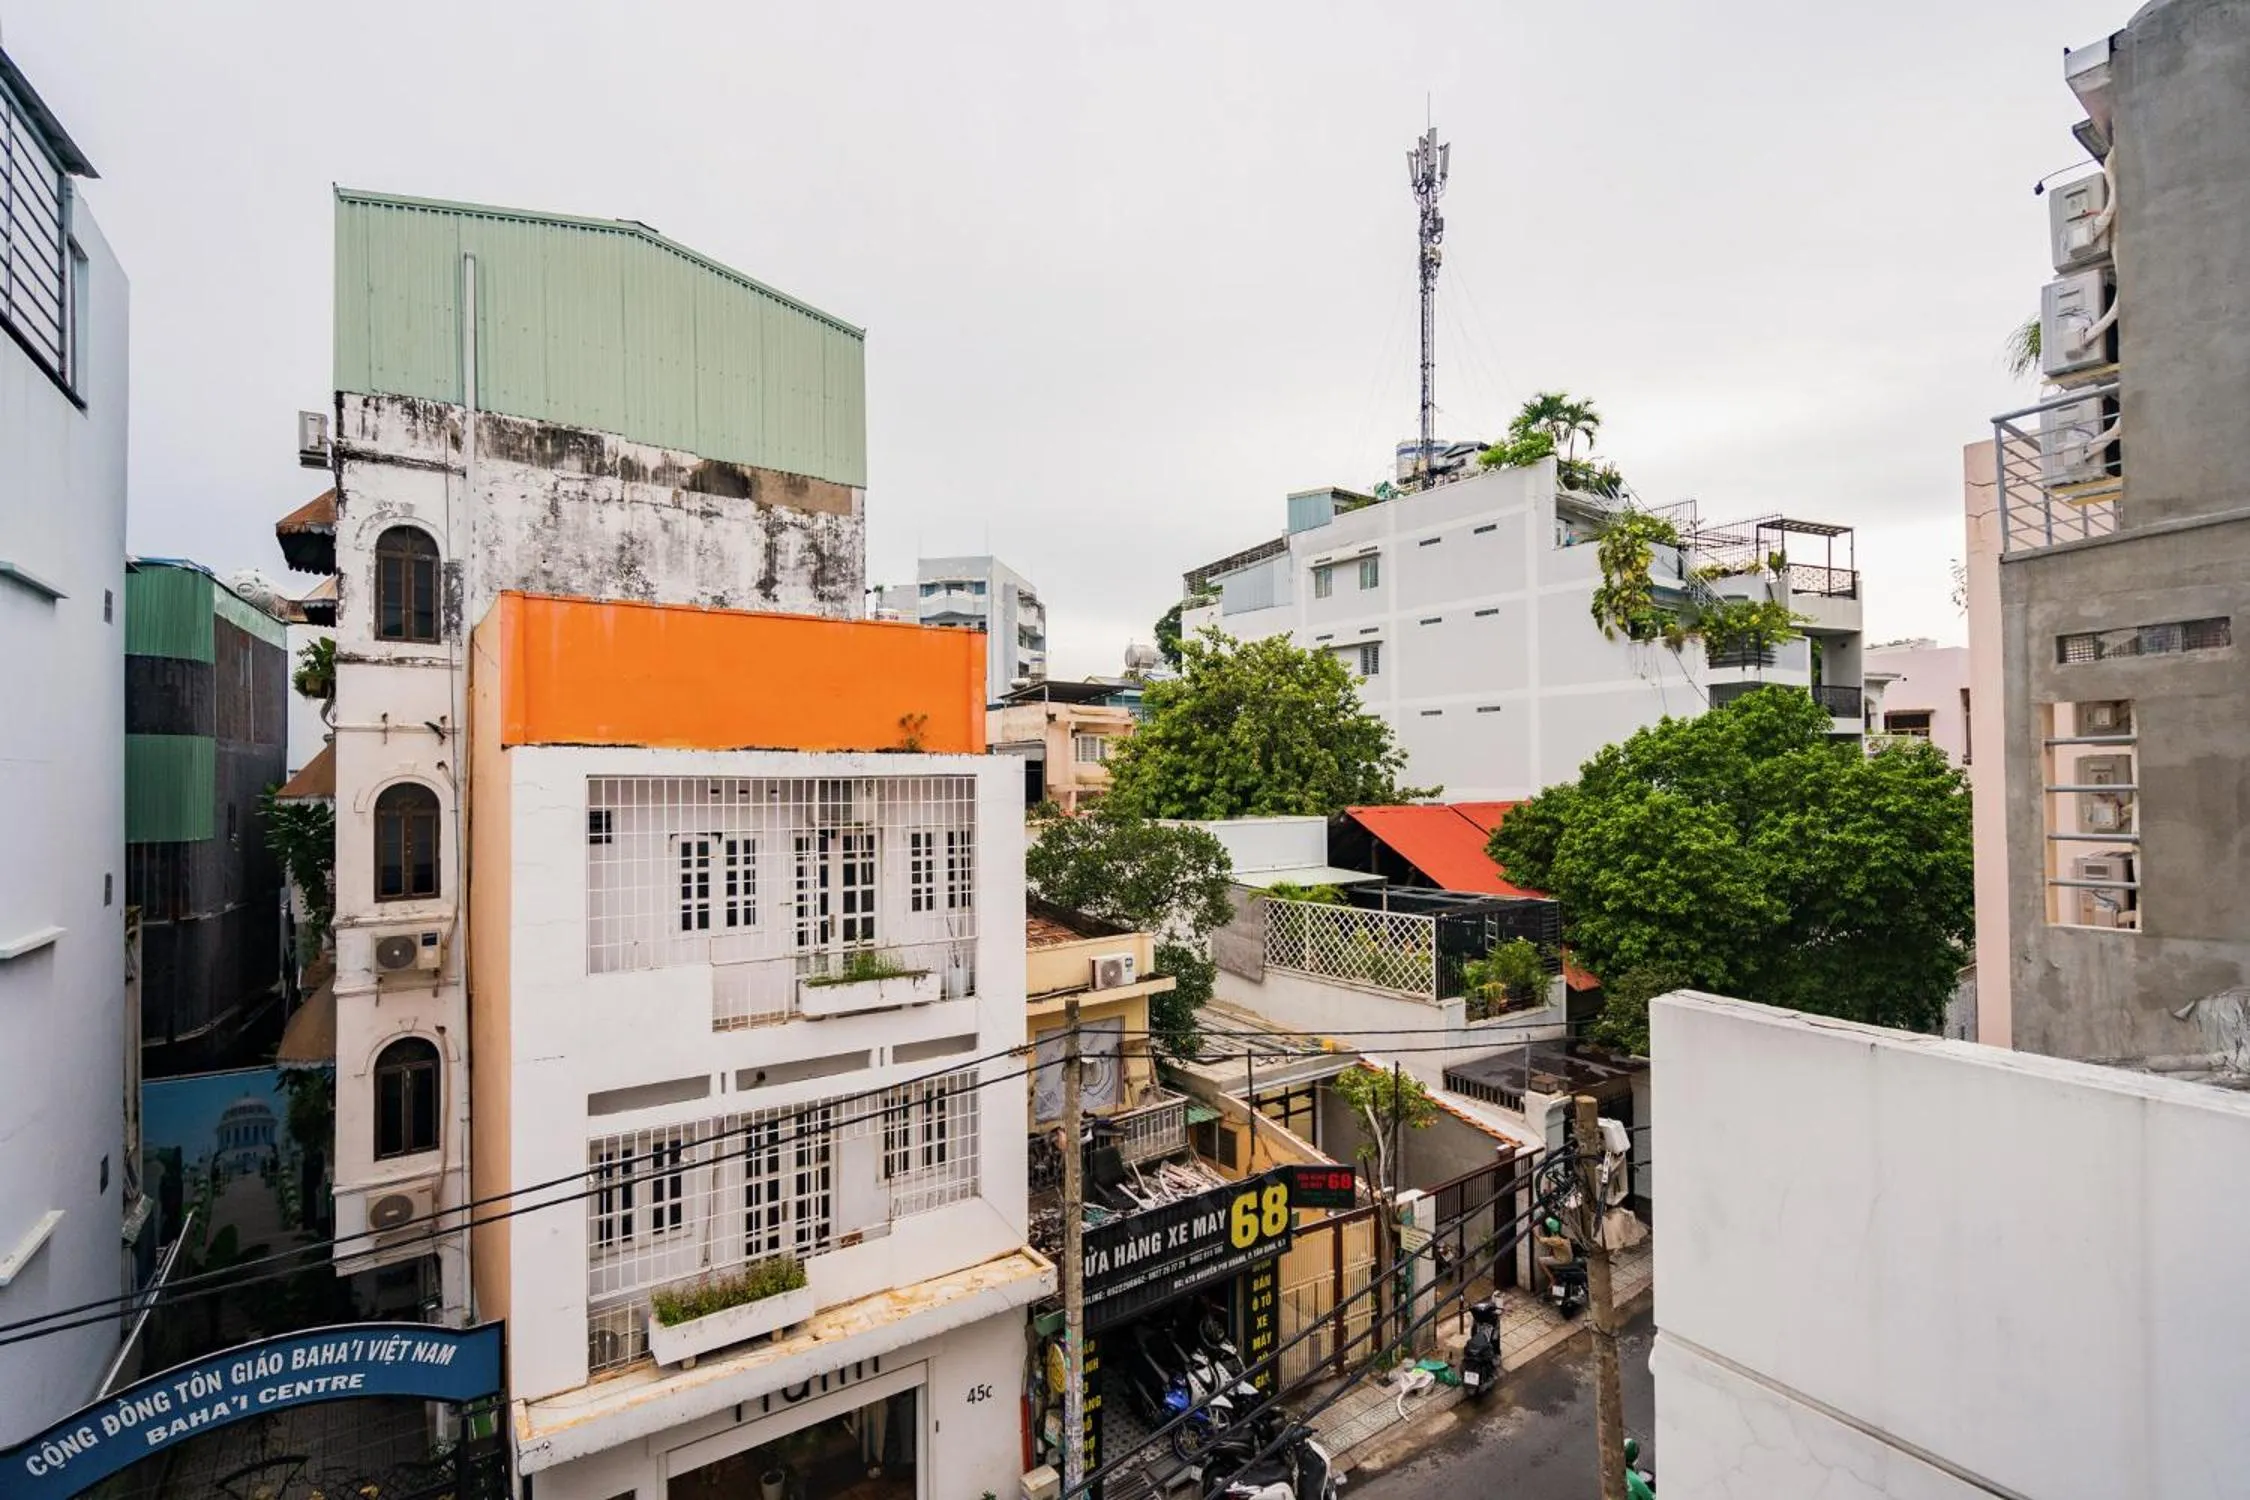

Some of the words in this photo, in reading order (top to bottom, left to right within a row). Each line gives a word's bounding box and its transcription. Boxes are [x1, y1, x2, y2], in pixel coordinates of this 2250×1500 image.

[1231, 1182, 1288, 1249] 68
[1085, 1245, 1110, 1278] ỬA
[1114, 1231, 1162, 1269] HÀNG
[1168, 1222, 1189, 1249] XE
[1256, 1314, 1269, 1331] XE
[26, 1426, 99, 1476] CỘNG
[101, 1399, 171, 1437] ĐỒNG
[174, 1370, 223, 1404] TÔN
[231, 1349, 283, 1385] GIÁO
[367, 1334, 412, 1365] VIỆT
[411, 1341, 457, 1366] NAM
[258, 1373, 365, 1404] CENTRE
